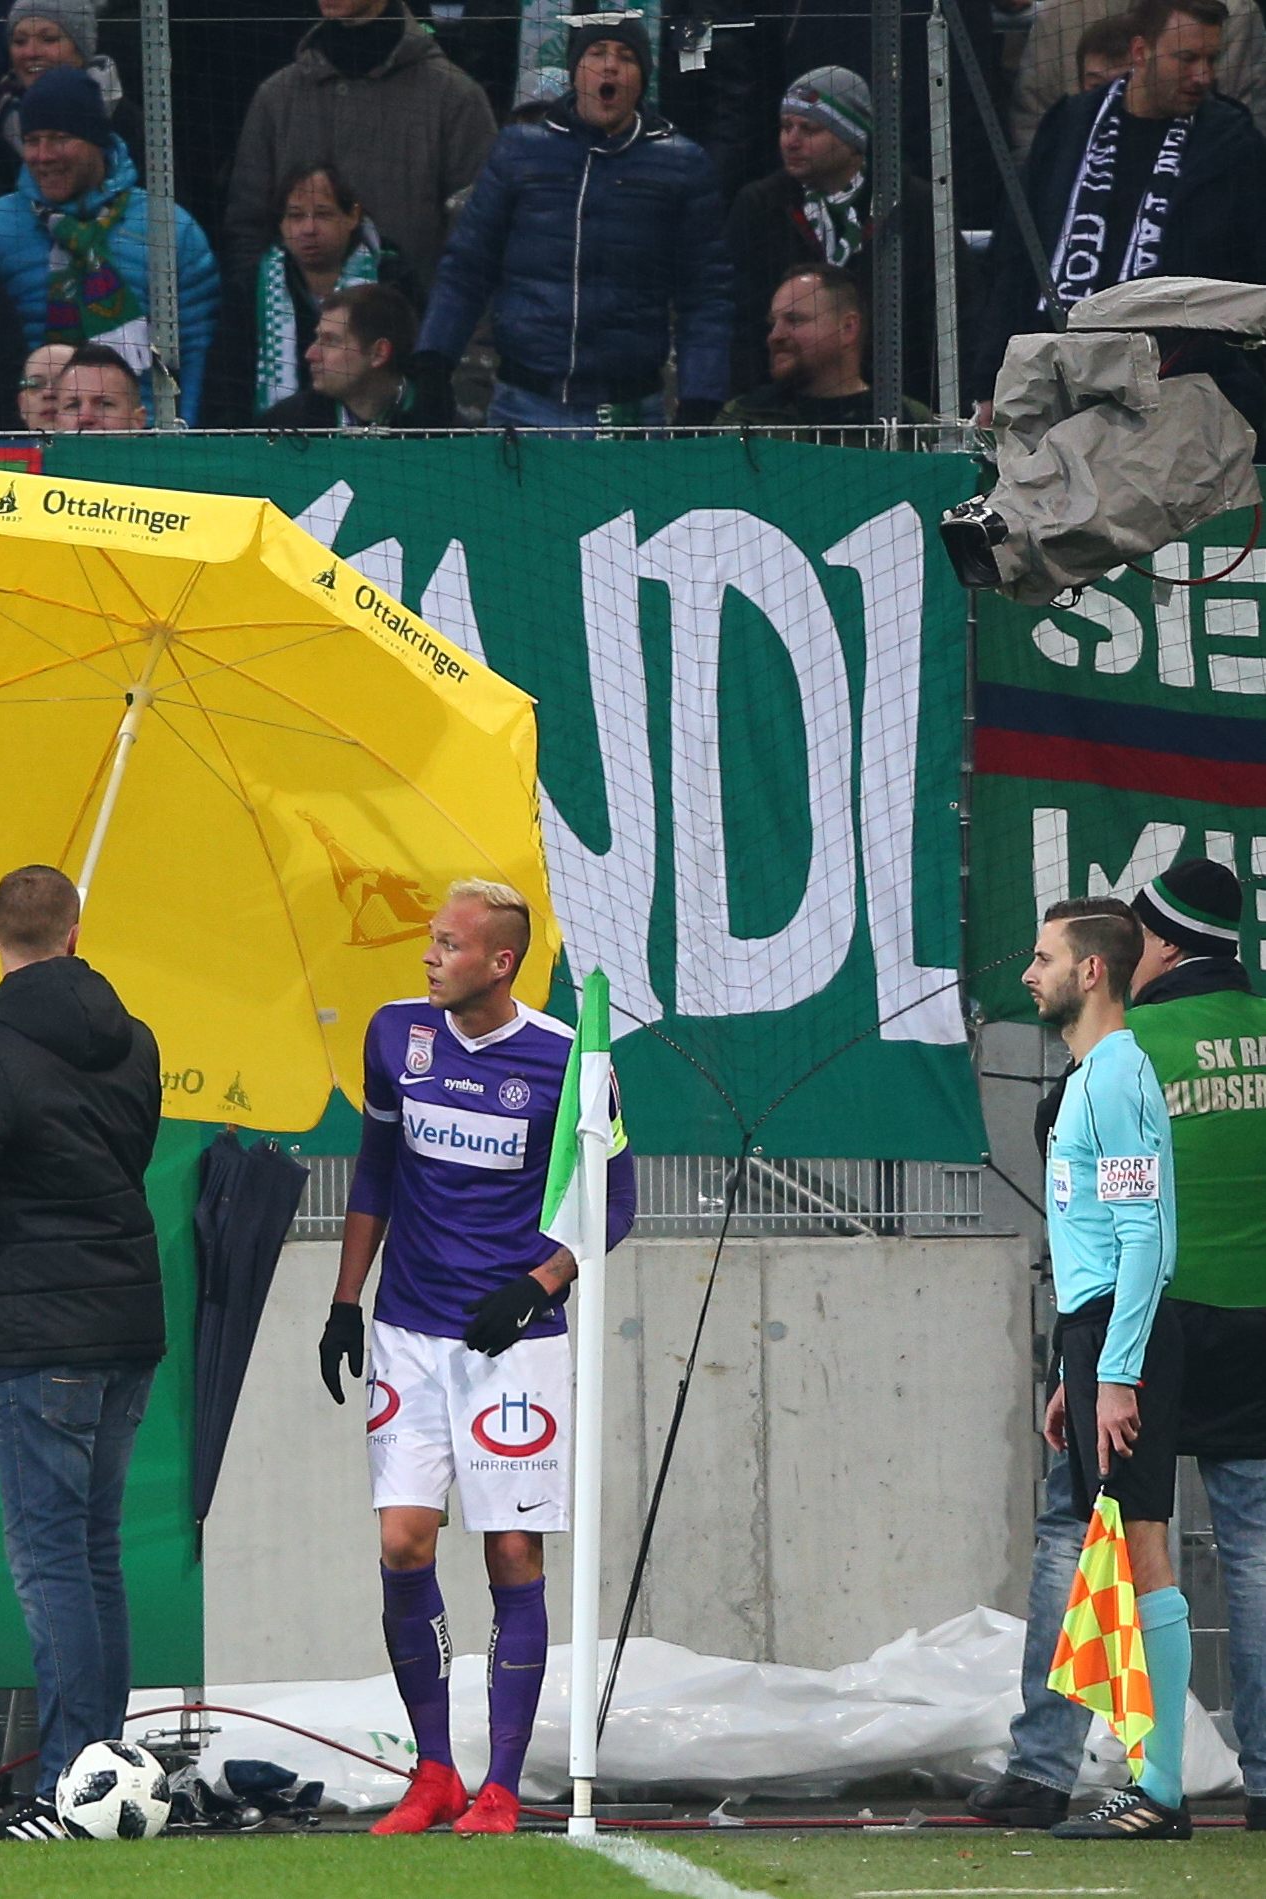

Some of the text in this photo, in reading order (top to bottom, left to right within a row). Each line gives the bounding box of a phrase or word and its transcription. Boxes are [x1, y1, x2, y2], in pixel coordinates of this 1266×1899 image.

[43, 489, 191, 534] Ottakringer
[355, 584, 469, 684] Ottakringer
[1195, 1039, 1236, 1071] SK
[444, 1078, 485, 1093] synthos
[407, 1114, 519, 1157] Verbund
[1100, 1158, 1155, 1172] SPORT
[1107, 1171, 1147, 1182] OHNE
[1100, 1181, 1155, 1193] DOPING
[470, 1459, 559, 1471] HARREITHER
